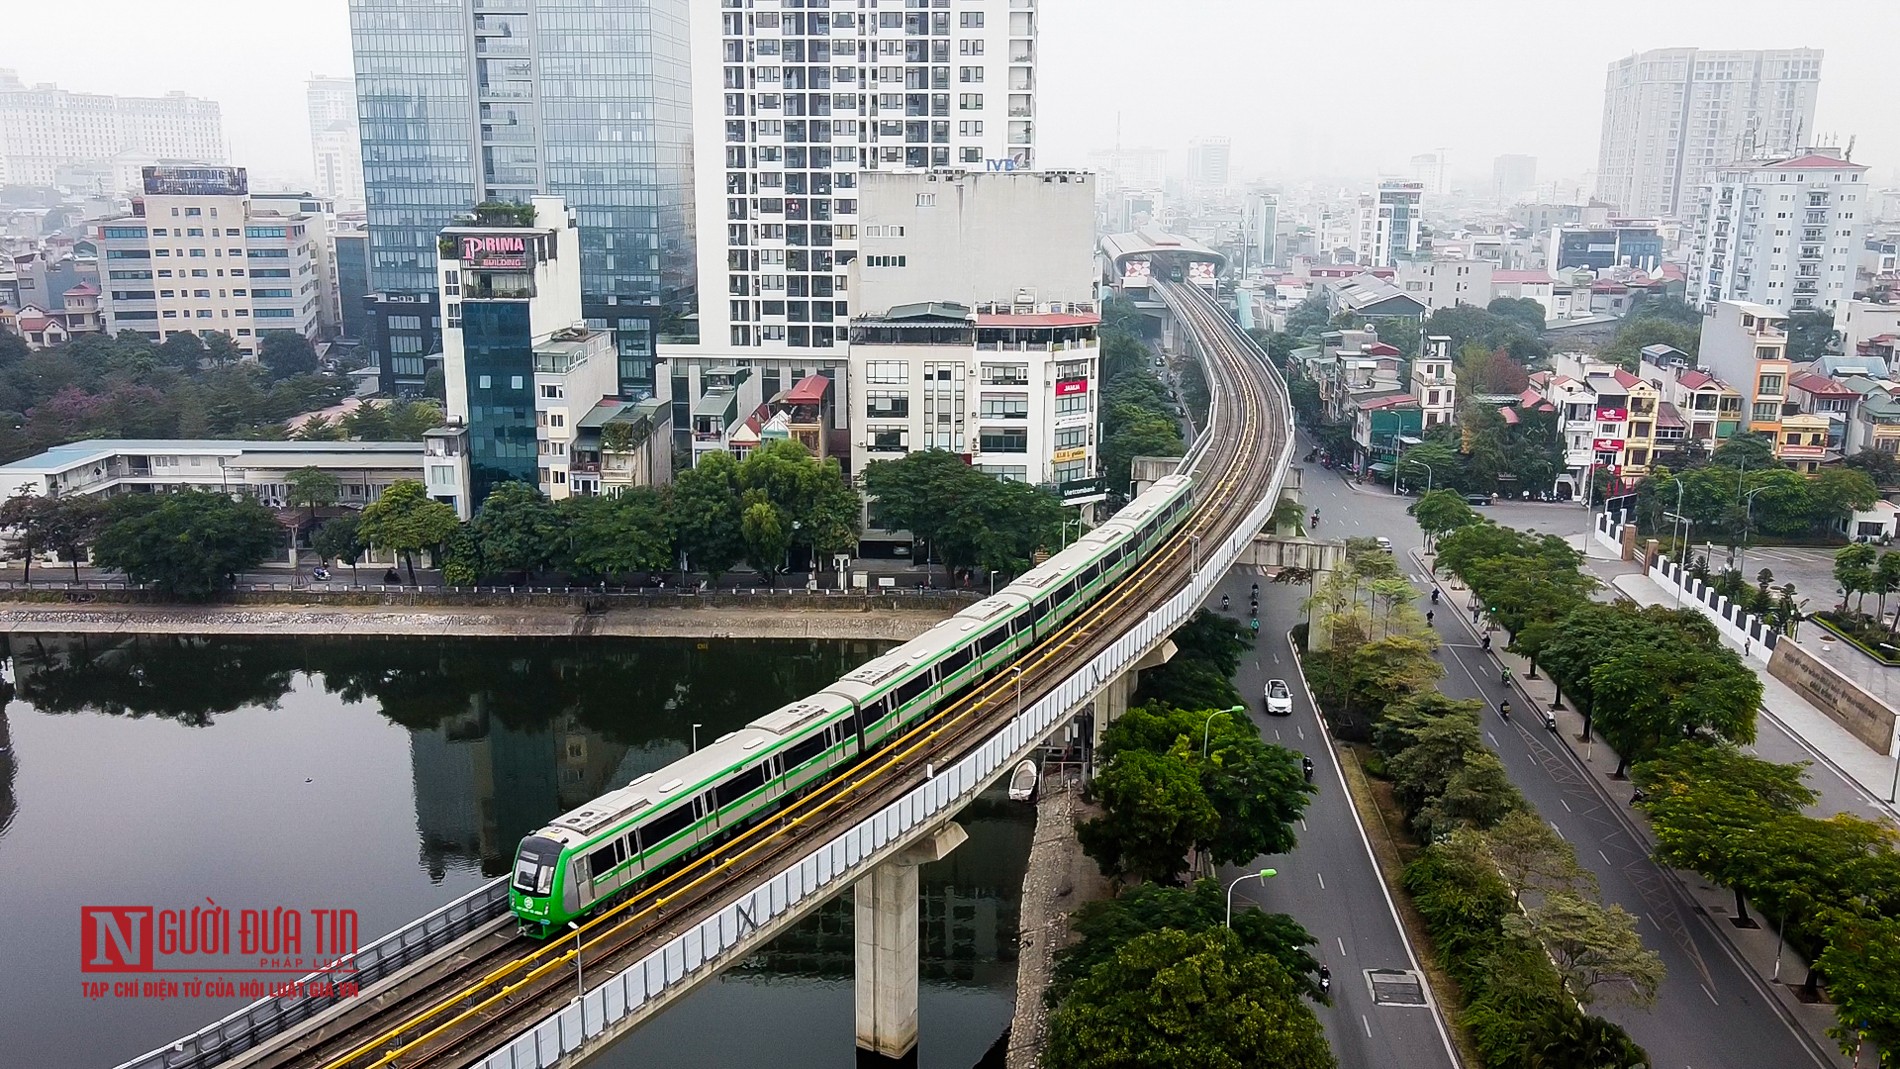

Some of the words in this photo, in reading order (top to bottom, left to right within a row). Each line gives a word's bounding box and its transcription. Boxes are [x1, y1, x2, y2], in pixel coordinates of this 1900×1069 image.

[986, 159, 1014, 171] IVB
[463, 237, 524, 260] PRIMA
[1064, 486, 1096, 496] Vietcombank
